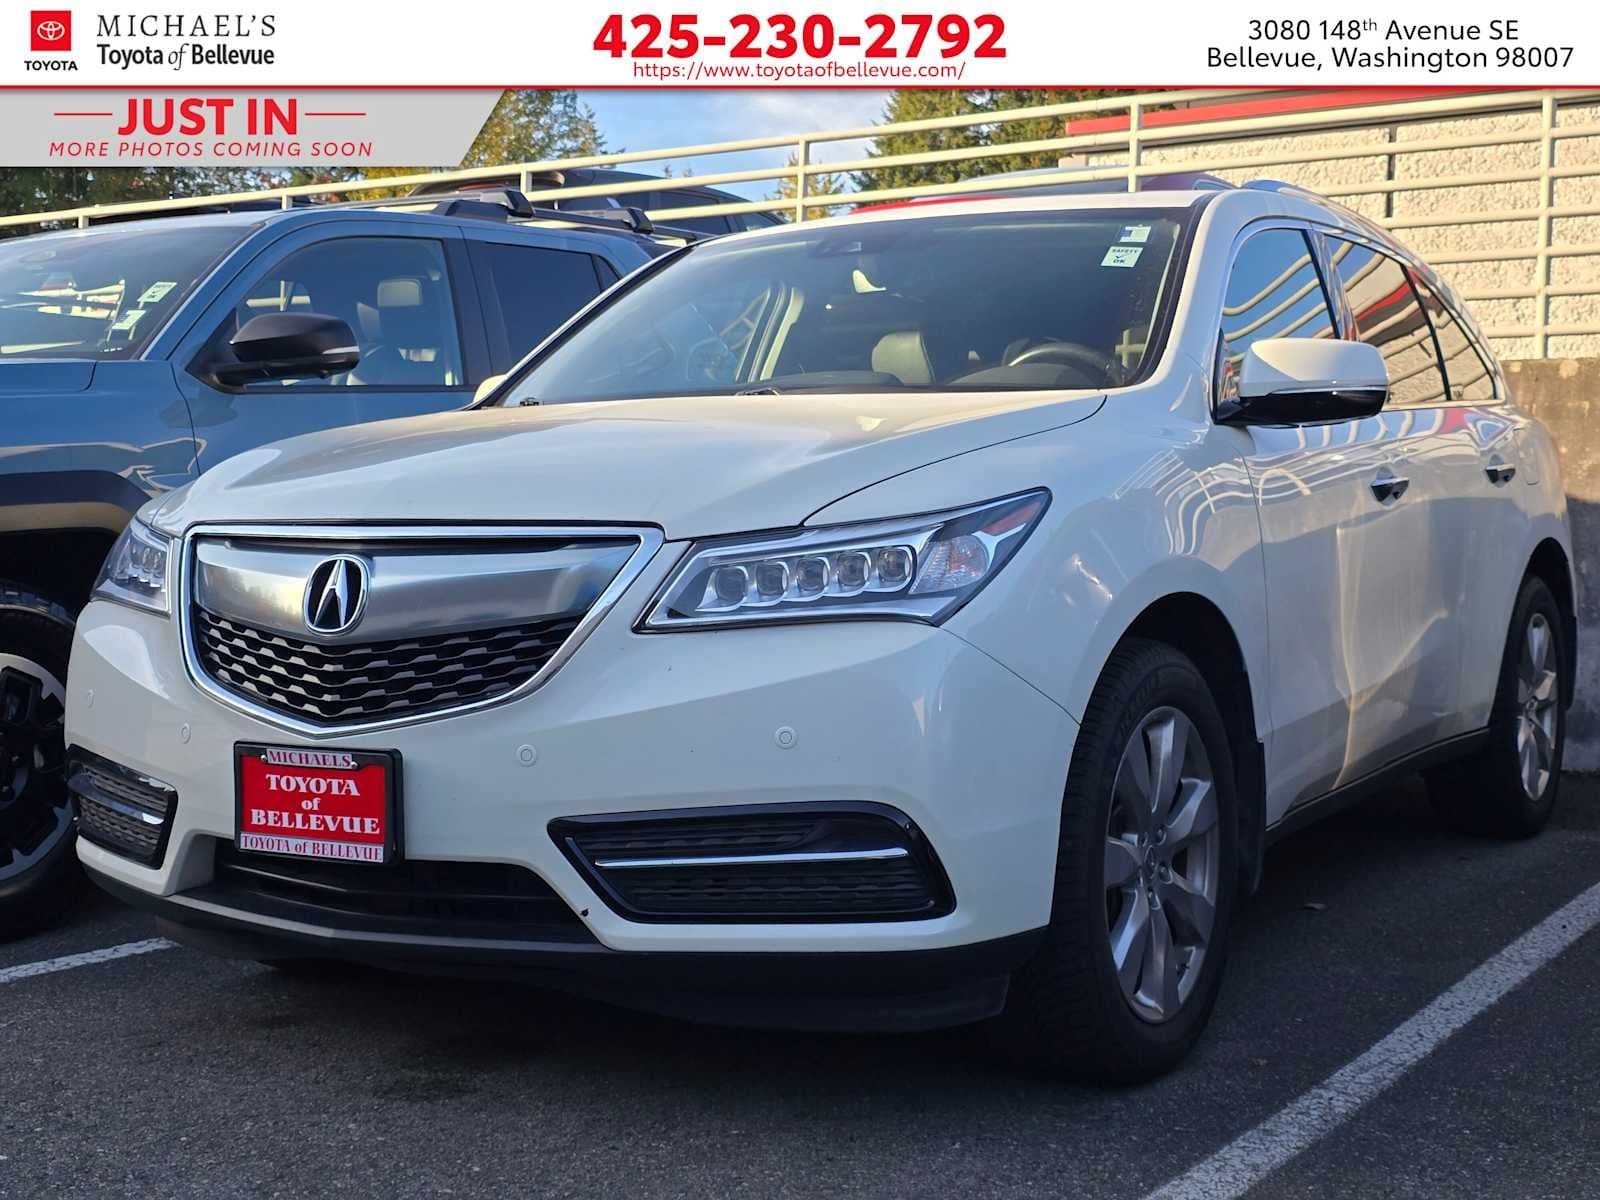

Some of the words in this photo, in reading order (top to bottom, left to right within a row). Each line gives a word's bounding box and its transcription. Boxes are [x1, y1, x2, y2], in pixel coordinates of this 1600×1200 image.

[268, 750, 351, 768] MICHAELS
[265, 774, 360, 796] TOYOTA
[301, 797, 321, 811] of
[251, 808, 381, 835] BELLEVUE
[242, 835, 290, 853] TOYOTA
[295, 843, 307, 854] of
[312, 845, 383, 861] BELLEVUE
